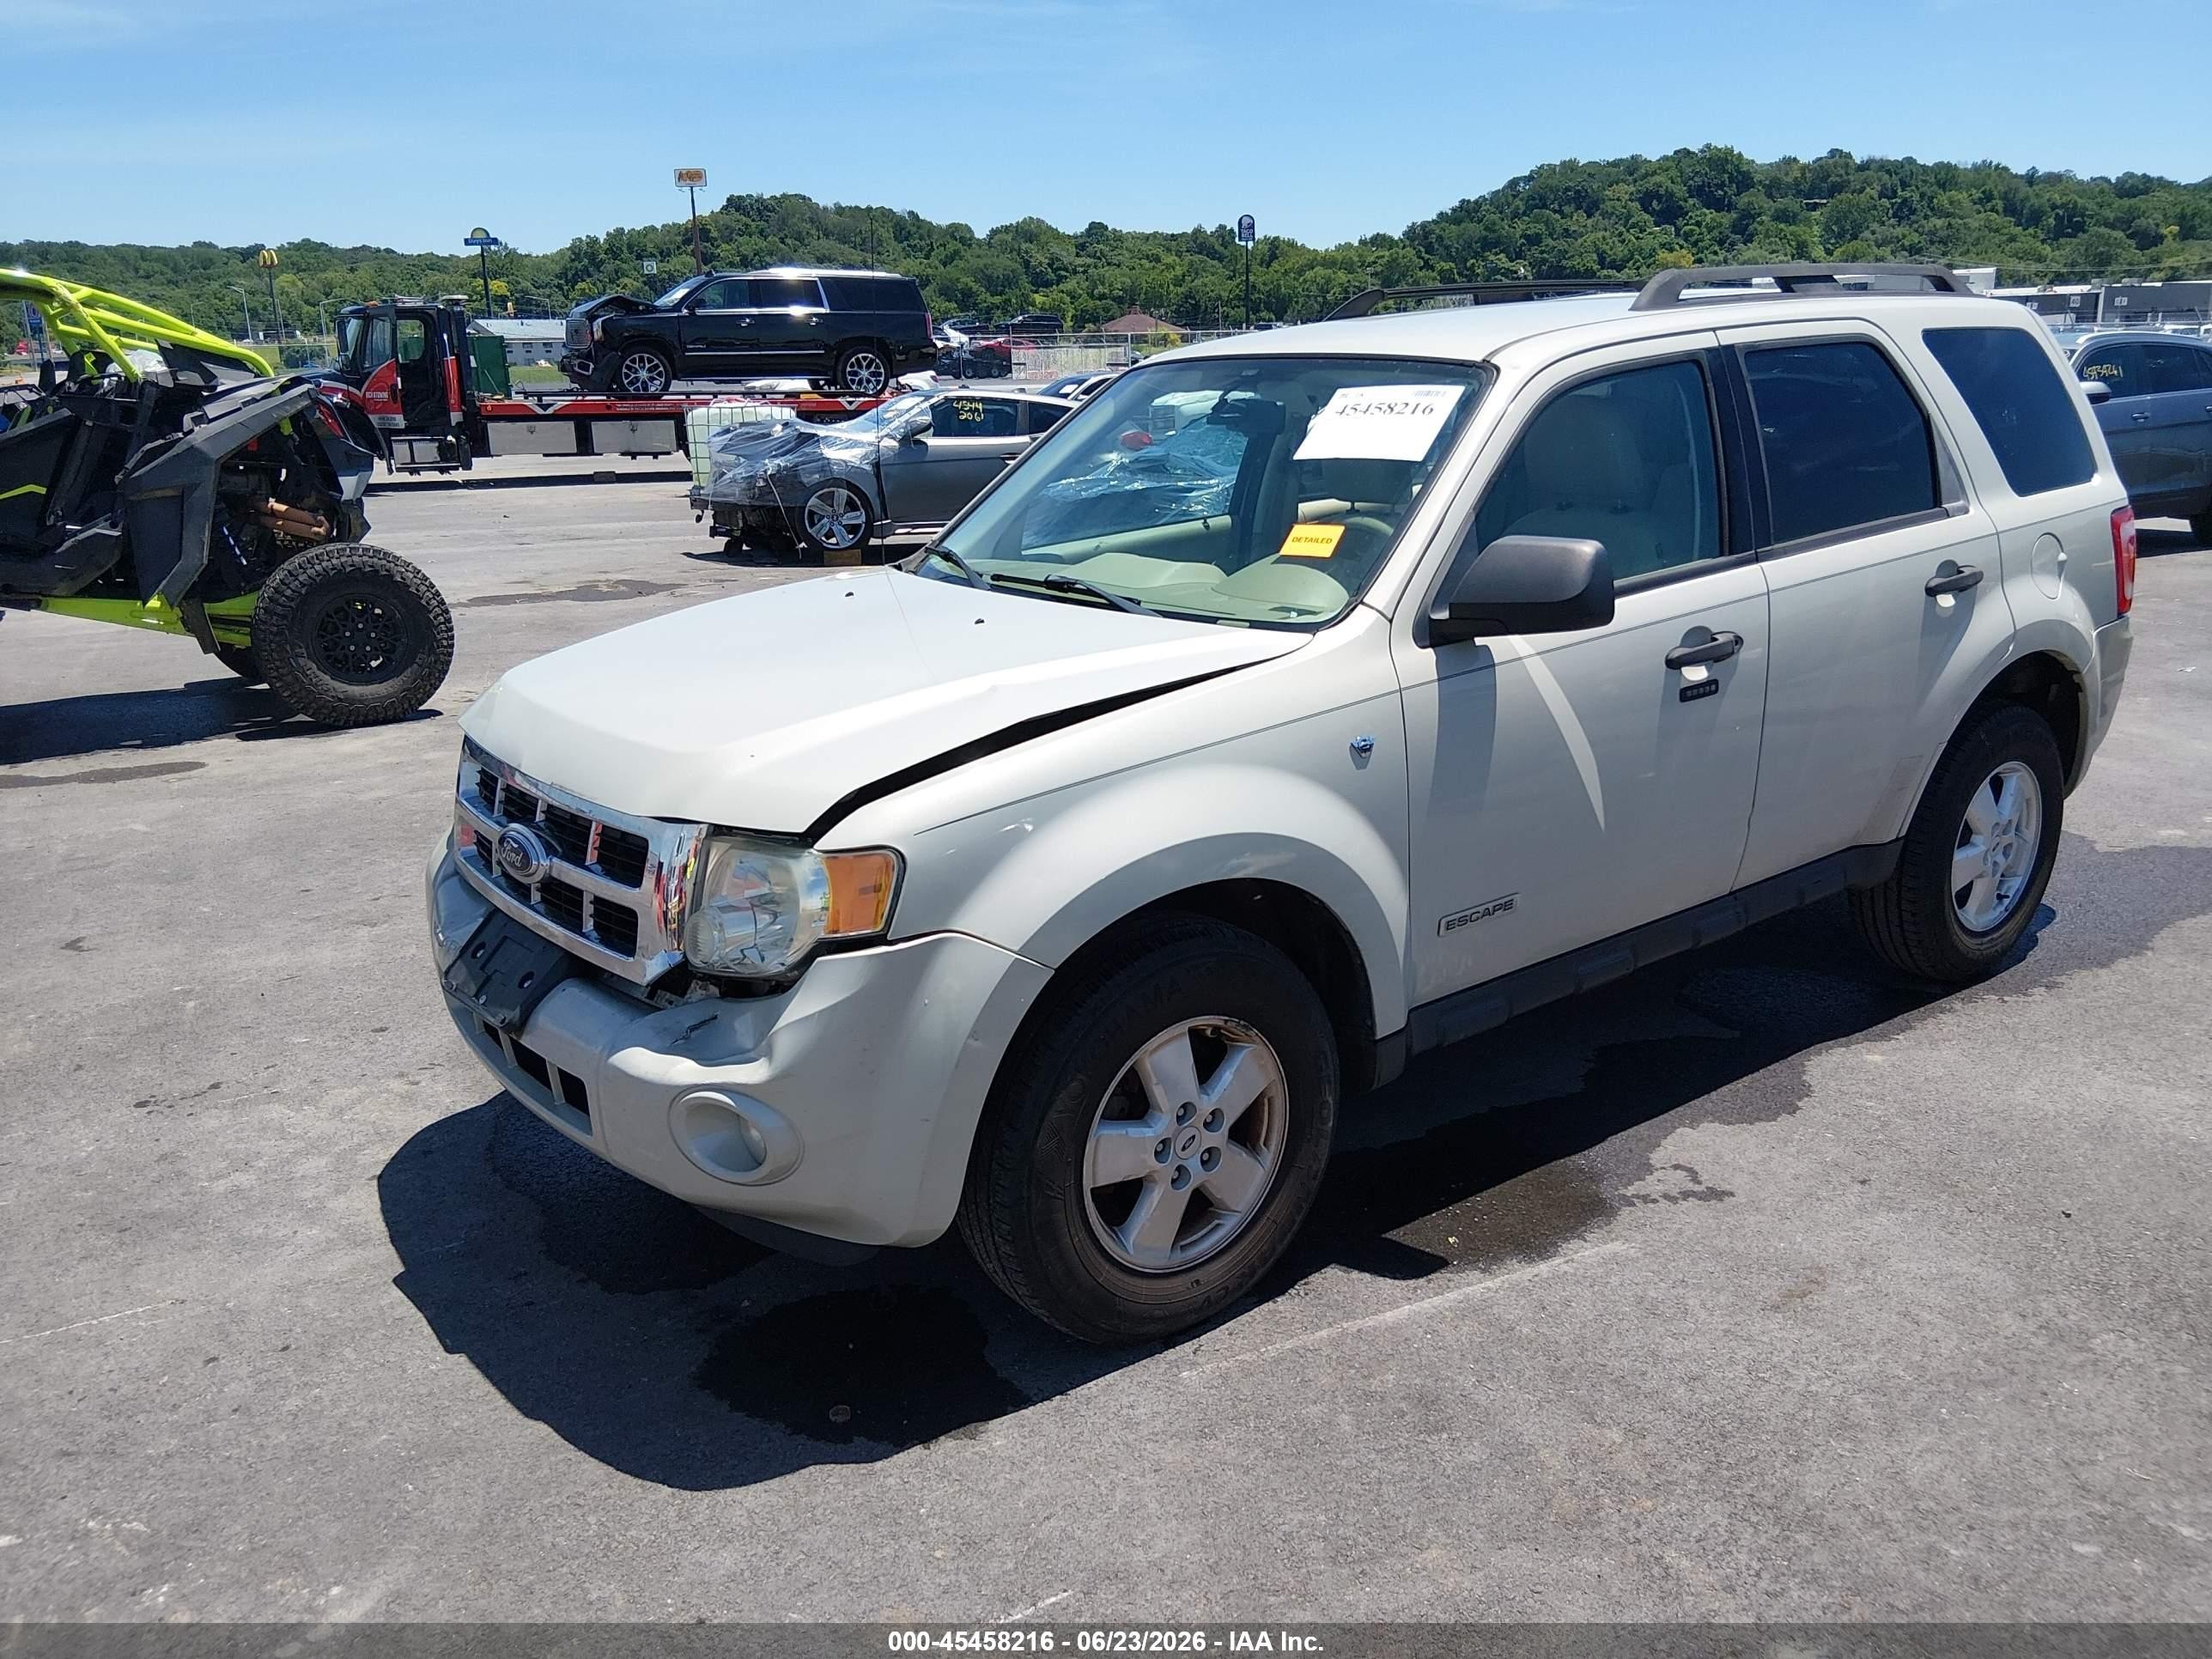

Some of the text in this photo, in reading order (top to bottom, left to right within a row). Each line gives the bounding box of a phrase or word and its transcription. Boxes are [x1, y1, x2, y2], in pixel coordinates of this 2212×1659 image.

[953, 400, 983, 412] 4544
[1335, 402, 1434, 416] 45458216
[501, 838, 524, 867] Ford
[1446, 898, 1515, 931] ESCAPE
